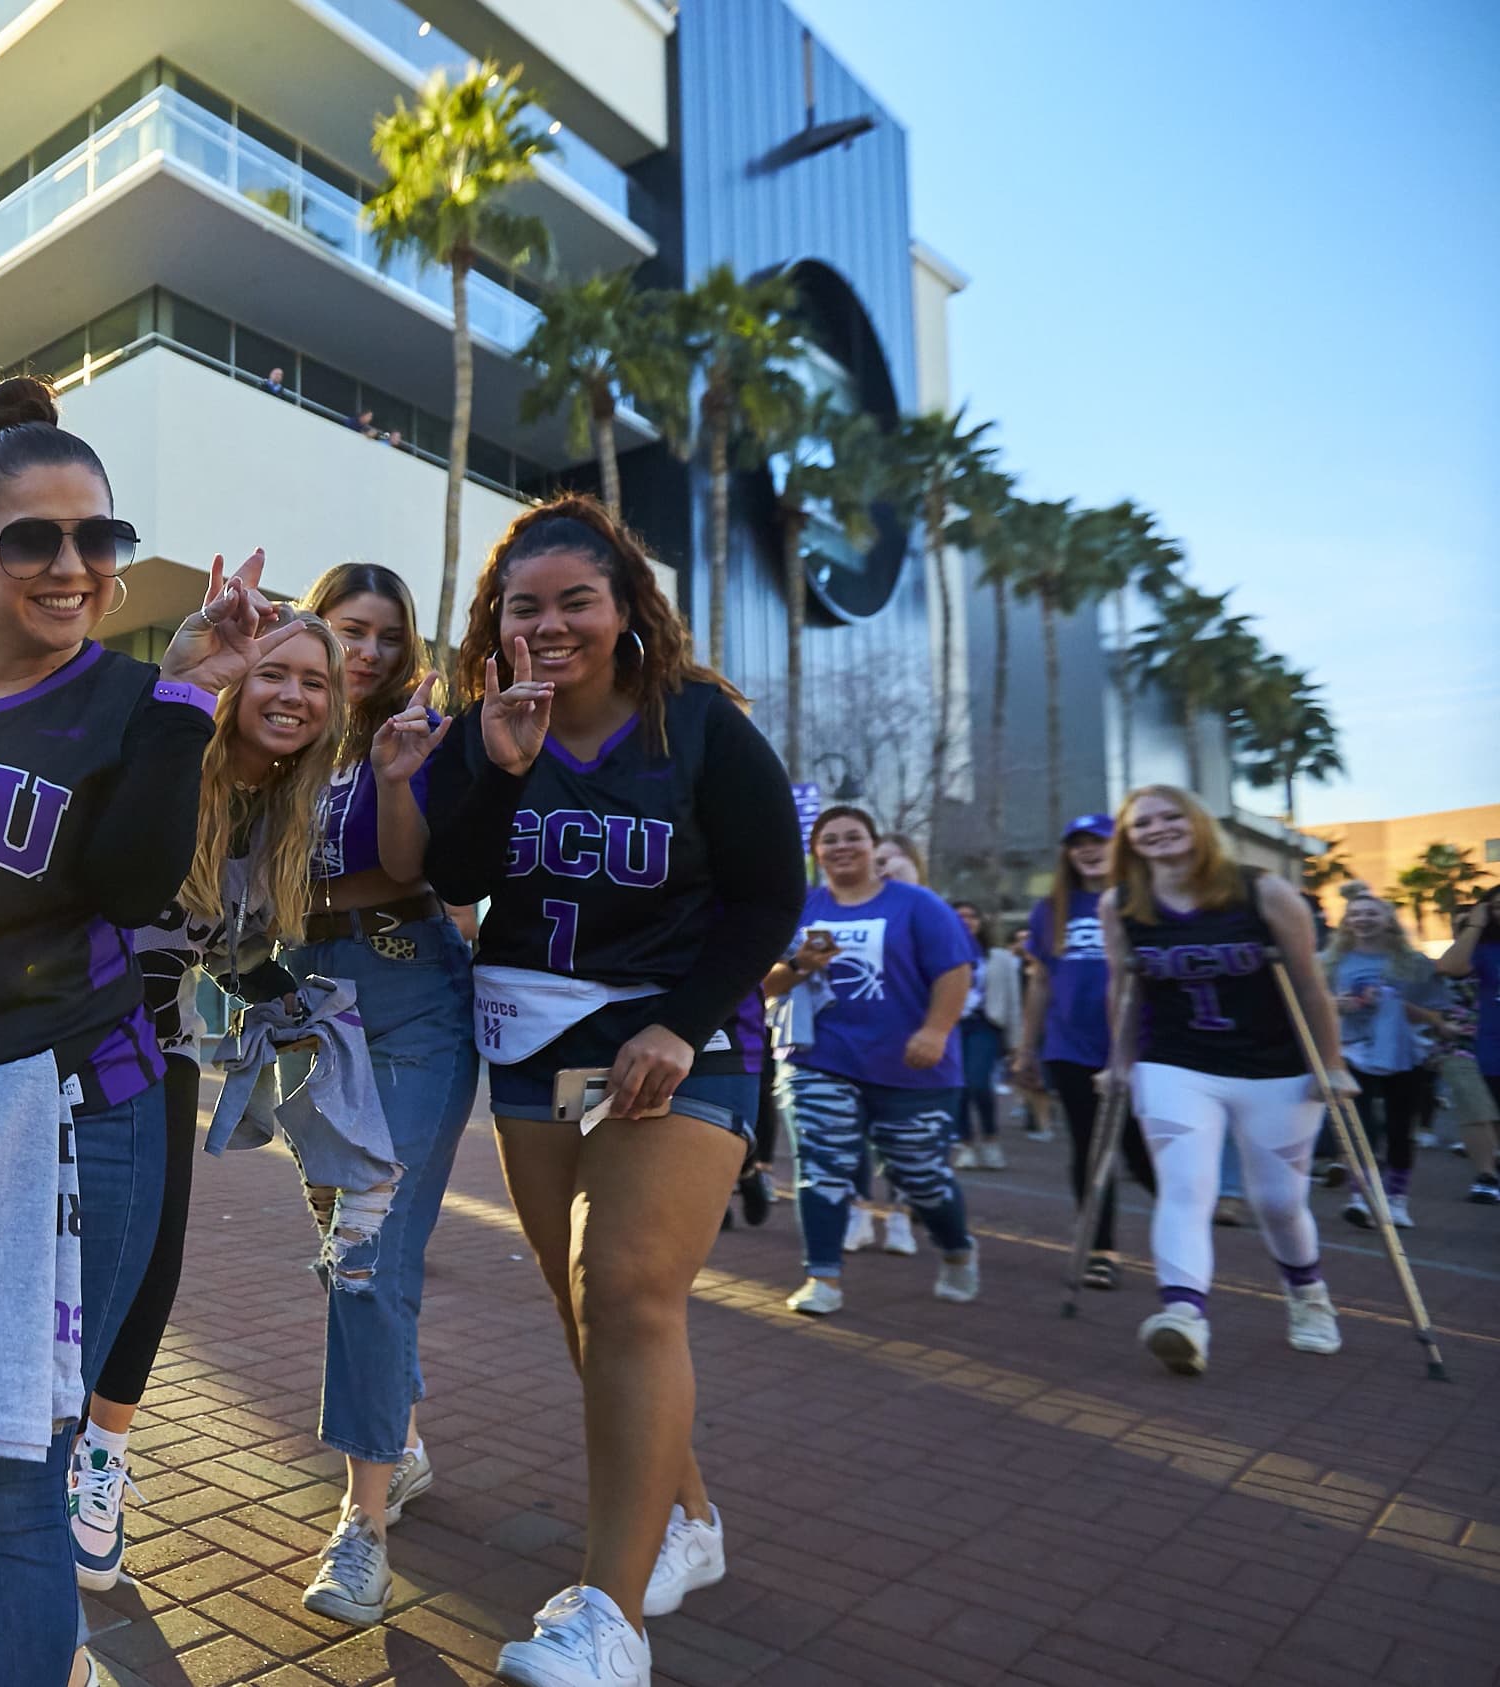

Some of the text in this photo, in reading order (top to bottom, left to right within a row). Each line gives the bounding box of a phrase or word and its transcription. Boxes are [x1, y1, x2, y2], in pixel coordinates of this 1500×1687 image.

[506, 809, 673, 888] GCU
[543, 898, 579, 972] 1
[1180, 981, 1237, 1031] 1
